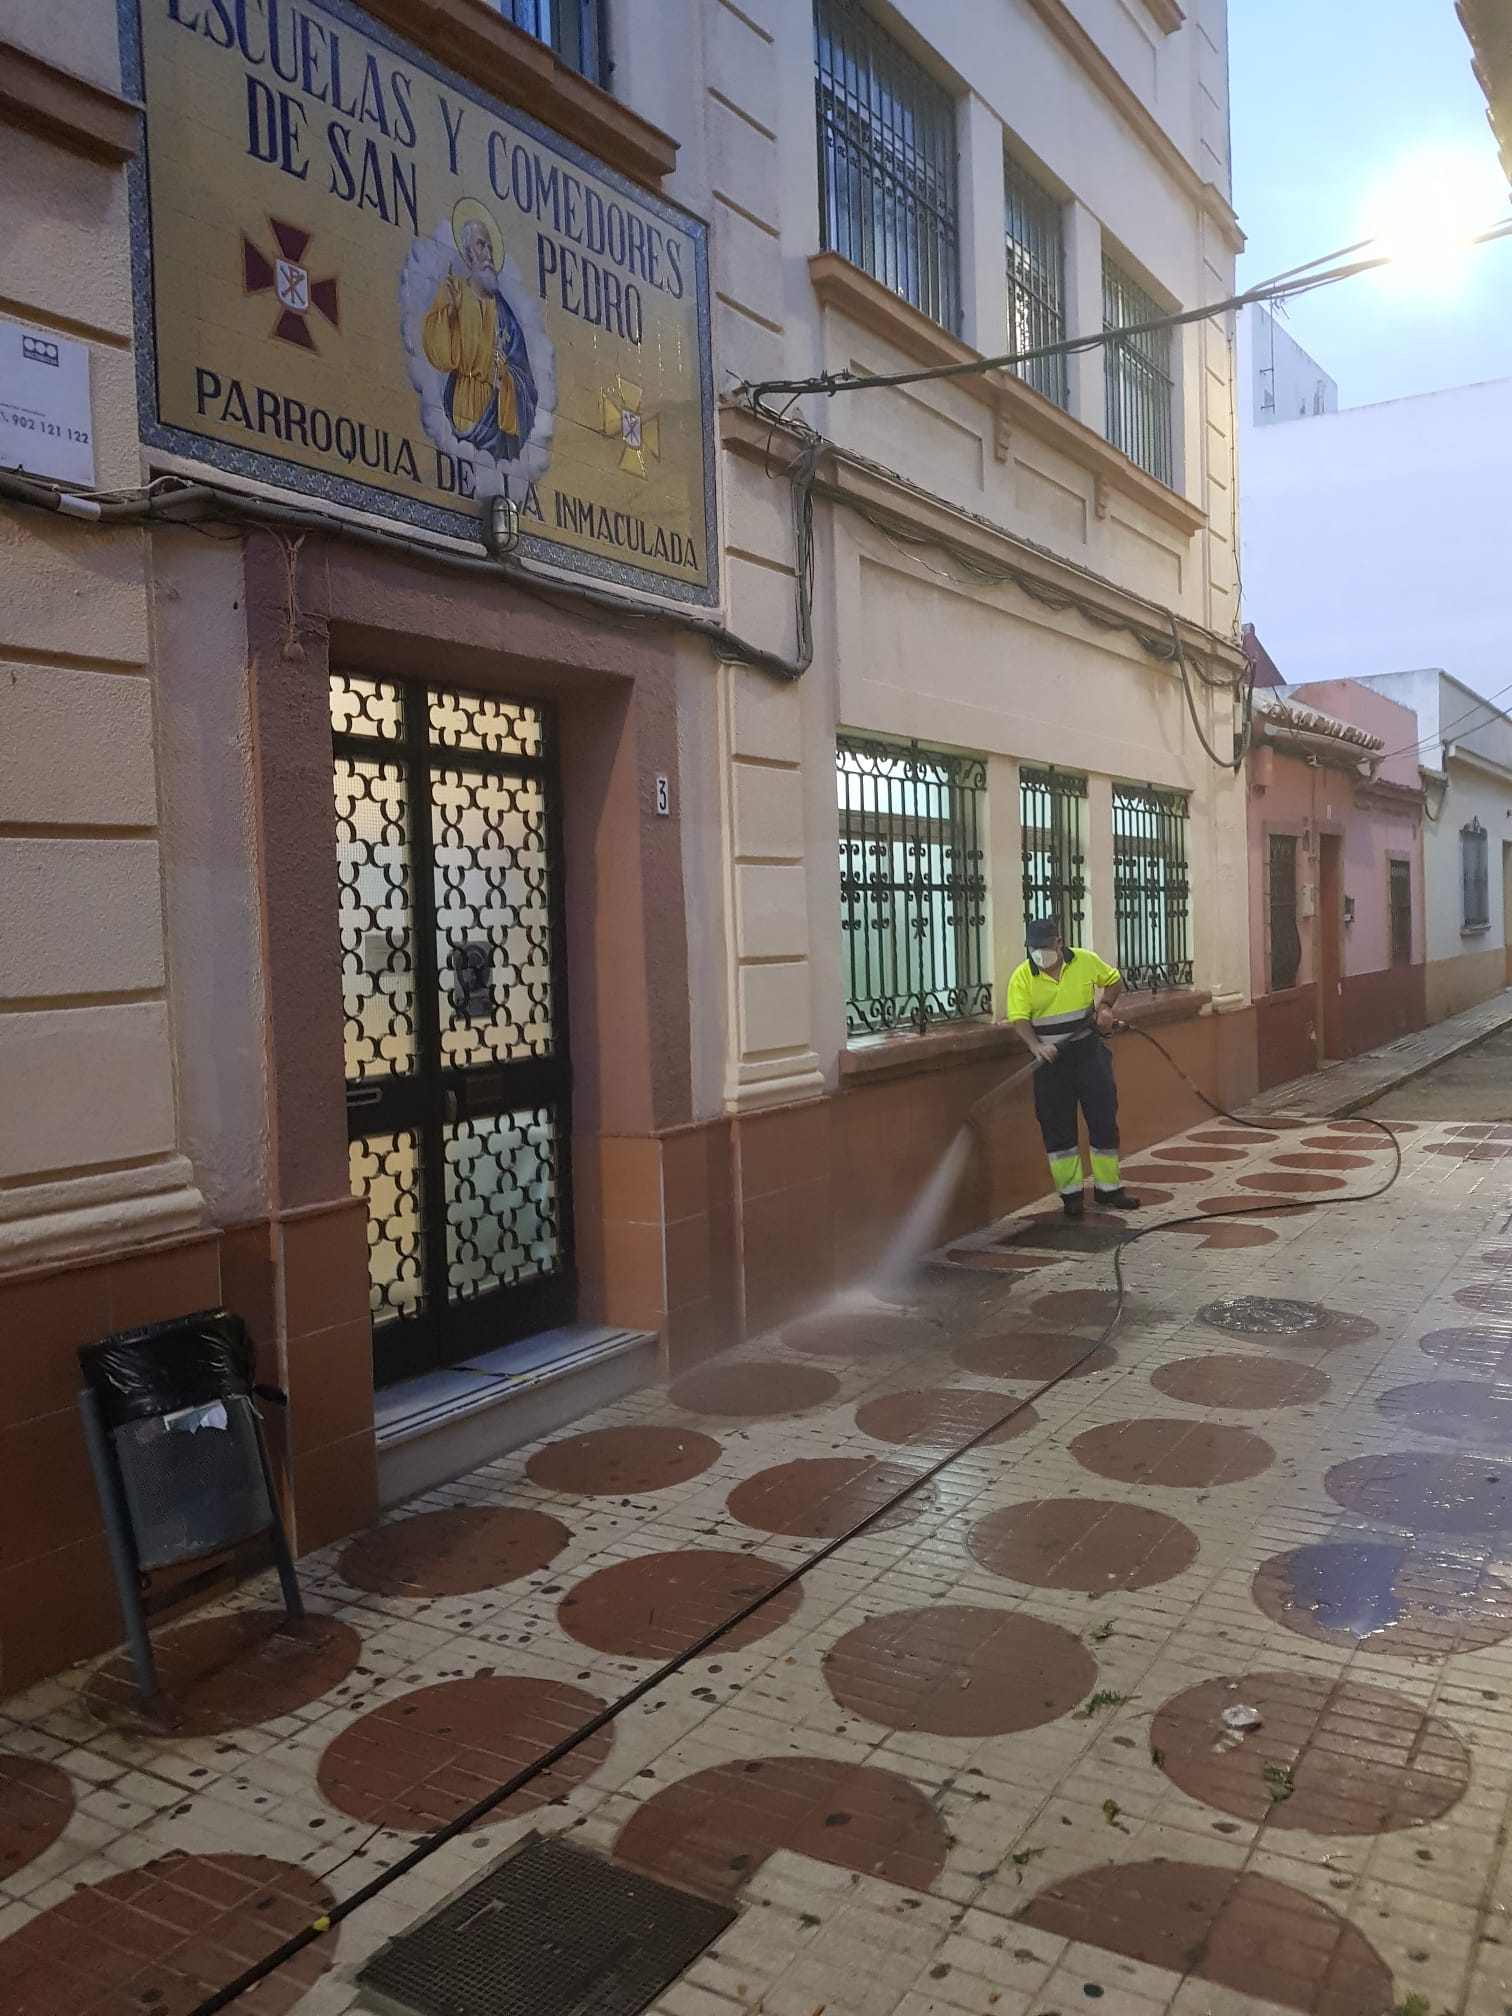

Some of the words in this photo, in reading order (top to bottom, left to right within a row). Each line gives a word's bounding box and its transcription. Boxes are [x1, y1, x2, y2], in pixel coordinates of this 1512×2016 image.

[245, 72, 309, 180] DE
[327, 121, 419, 236] SAN
[537, 231, 642, 346] PEDRO
[439, 95, 465, 176] Y
[488, 130, 684, 299] COMEDORES
[12, 414, 35, 430] 902
[40, 421, 61, 437] 121
[67, 428, 89, 444] 122
[195, 366, 423, 484] PARROQUIA
[436, 450, 477, 499] DE
[554, 489, 699, 571] INMACULADA
[659, 780, 667, 810] 3
